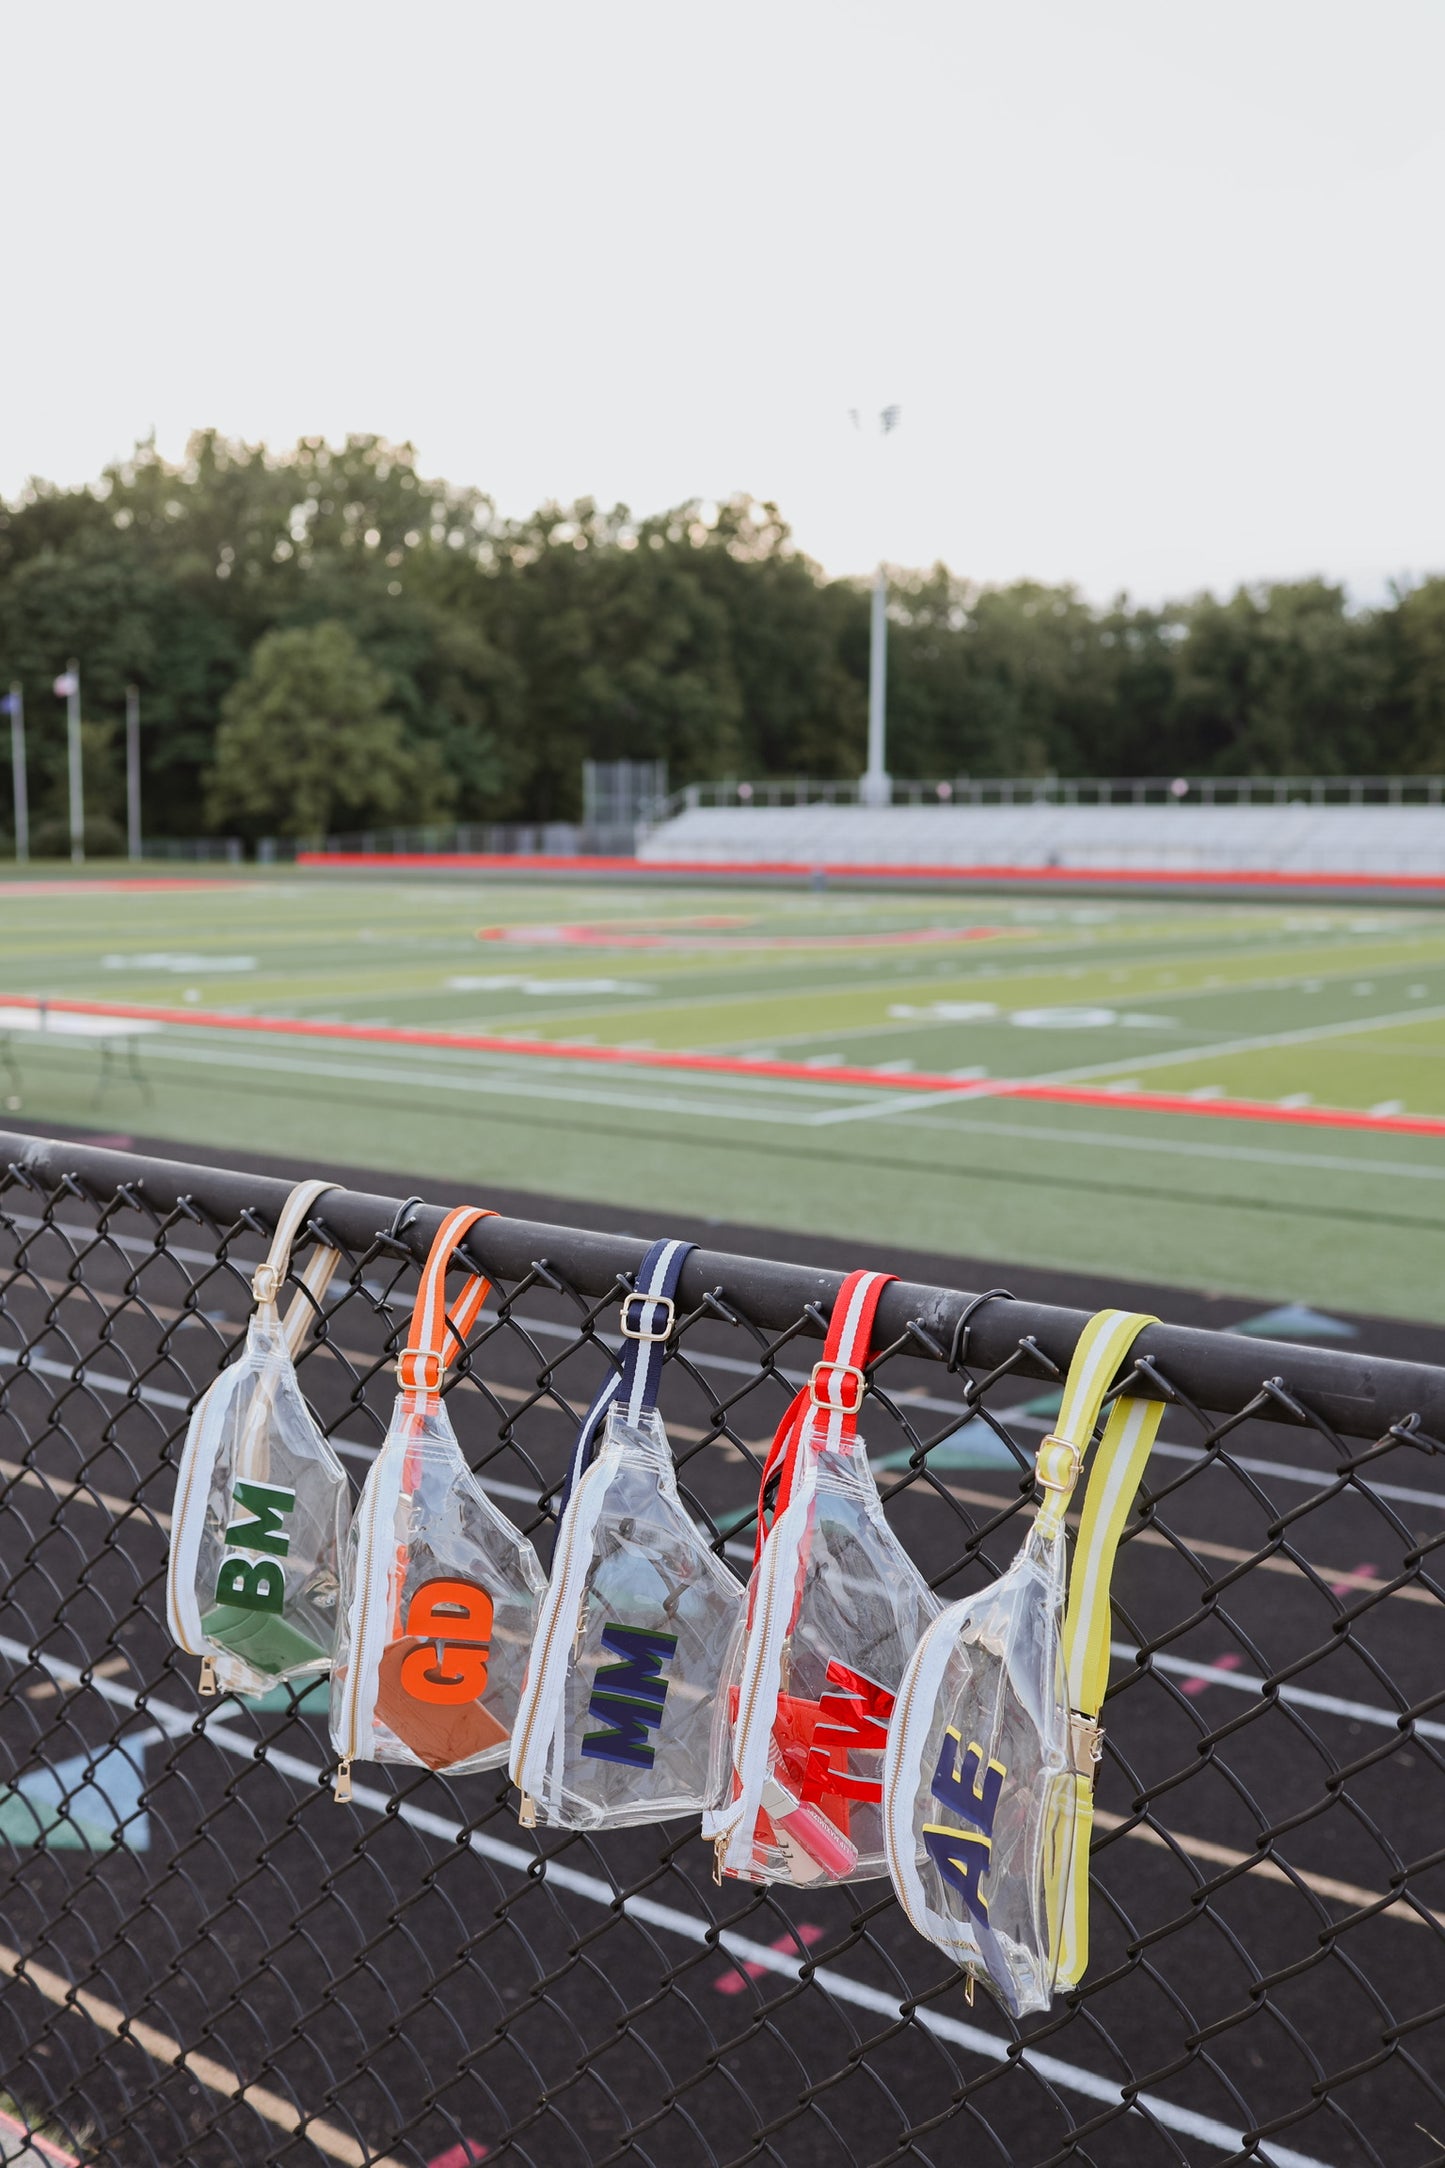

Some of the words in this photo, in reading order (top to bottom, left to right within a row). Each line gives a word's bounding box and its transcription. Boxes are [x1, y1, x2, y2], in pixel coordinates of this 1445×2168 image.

[216, 1477, 296, 1614] BM
[400, 1576, 494, 1706] GD
[580, 1622, 678, 1769] MM
[922, 1724, 1008, 1930] AE
